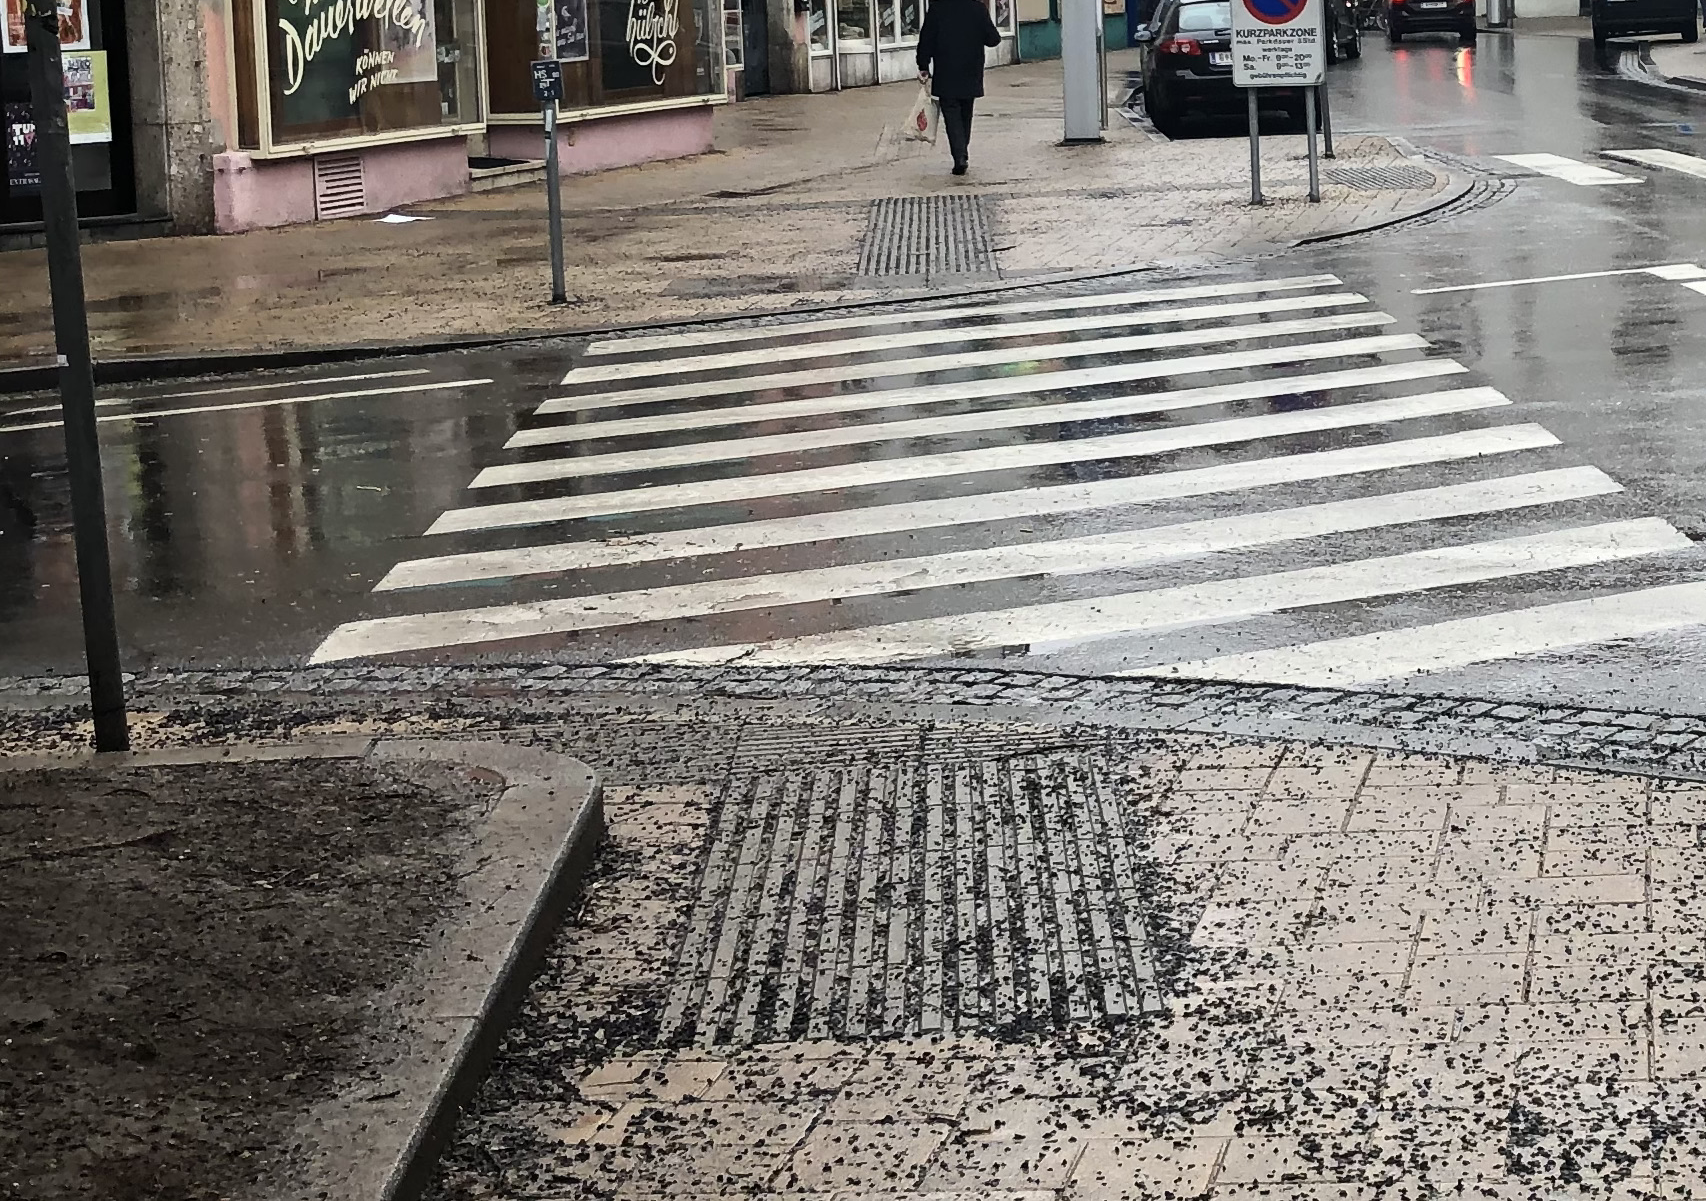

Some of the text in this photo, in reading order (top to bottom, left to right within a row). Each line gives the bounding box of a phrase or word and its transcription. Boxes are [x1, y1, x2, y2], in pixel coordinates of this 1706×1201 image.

[1236, 28, 1317, 38] KURZPARKZONE
[355, 49, 395, 76] KÖNNEN
[348, 68, 399, 105] WIR NICHT
